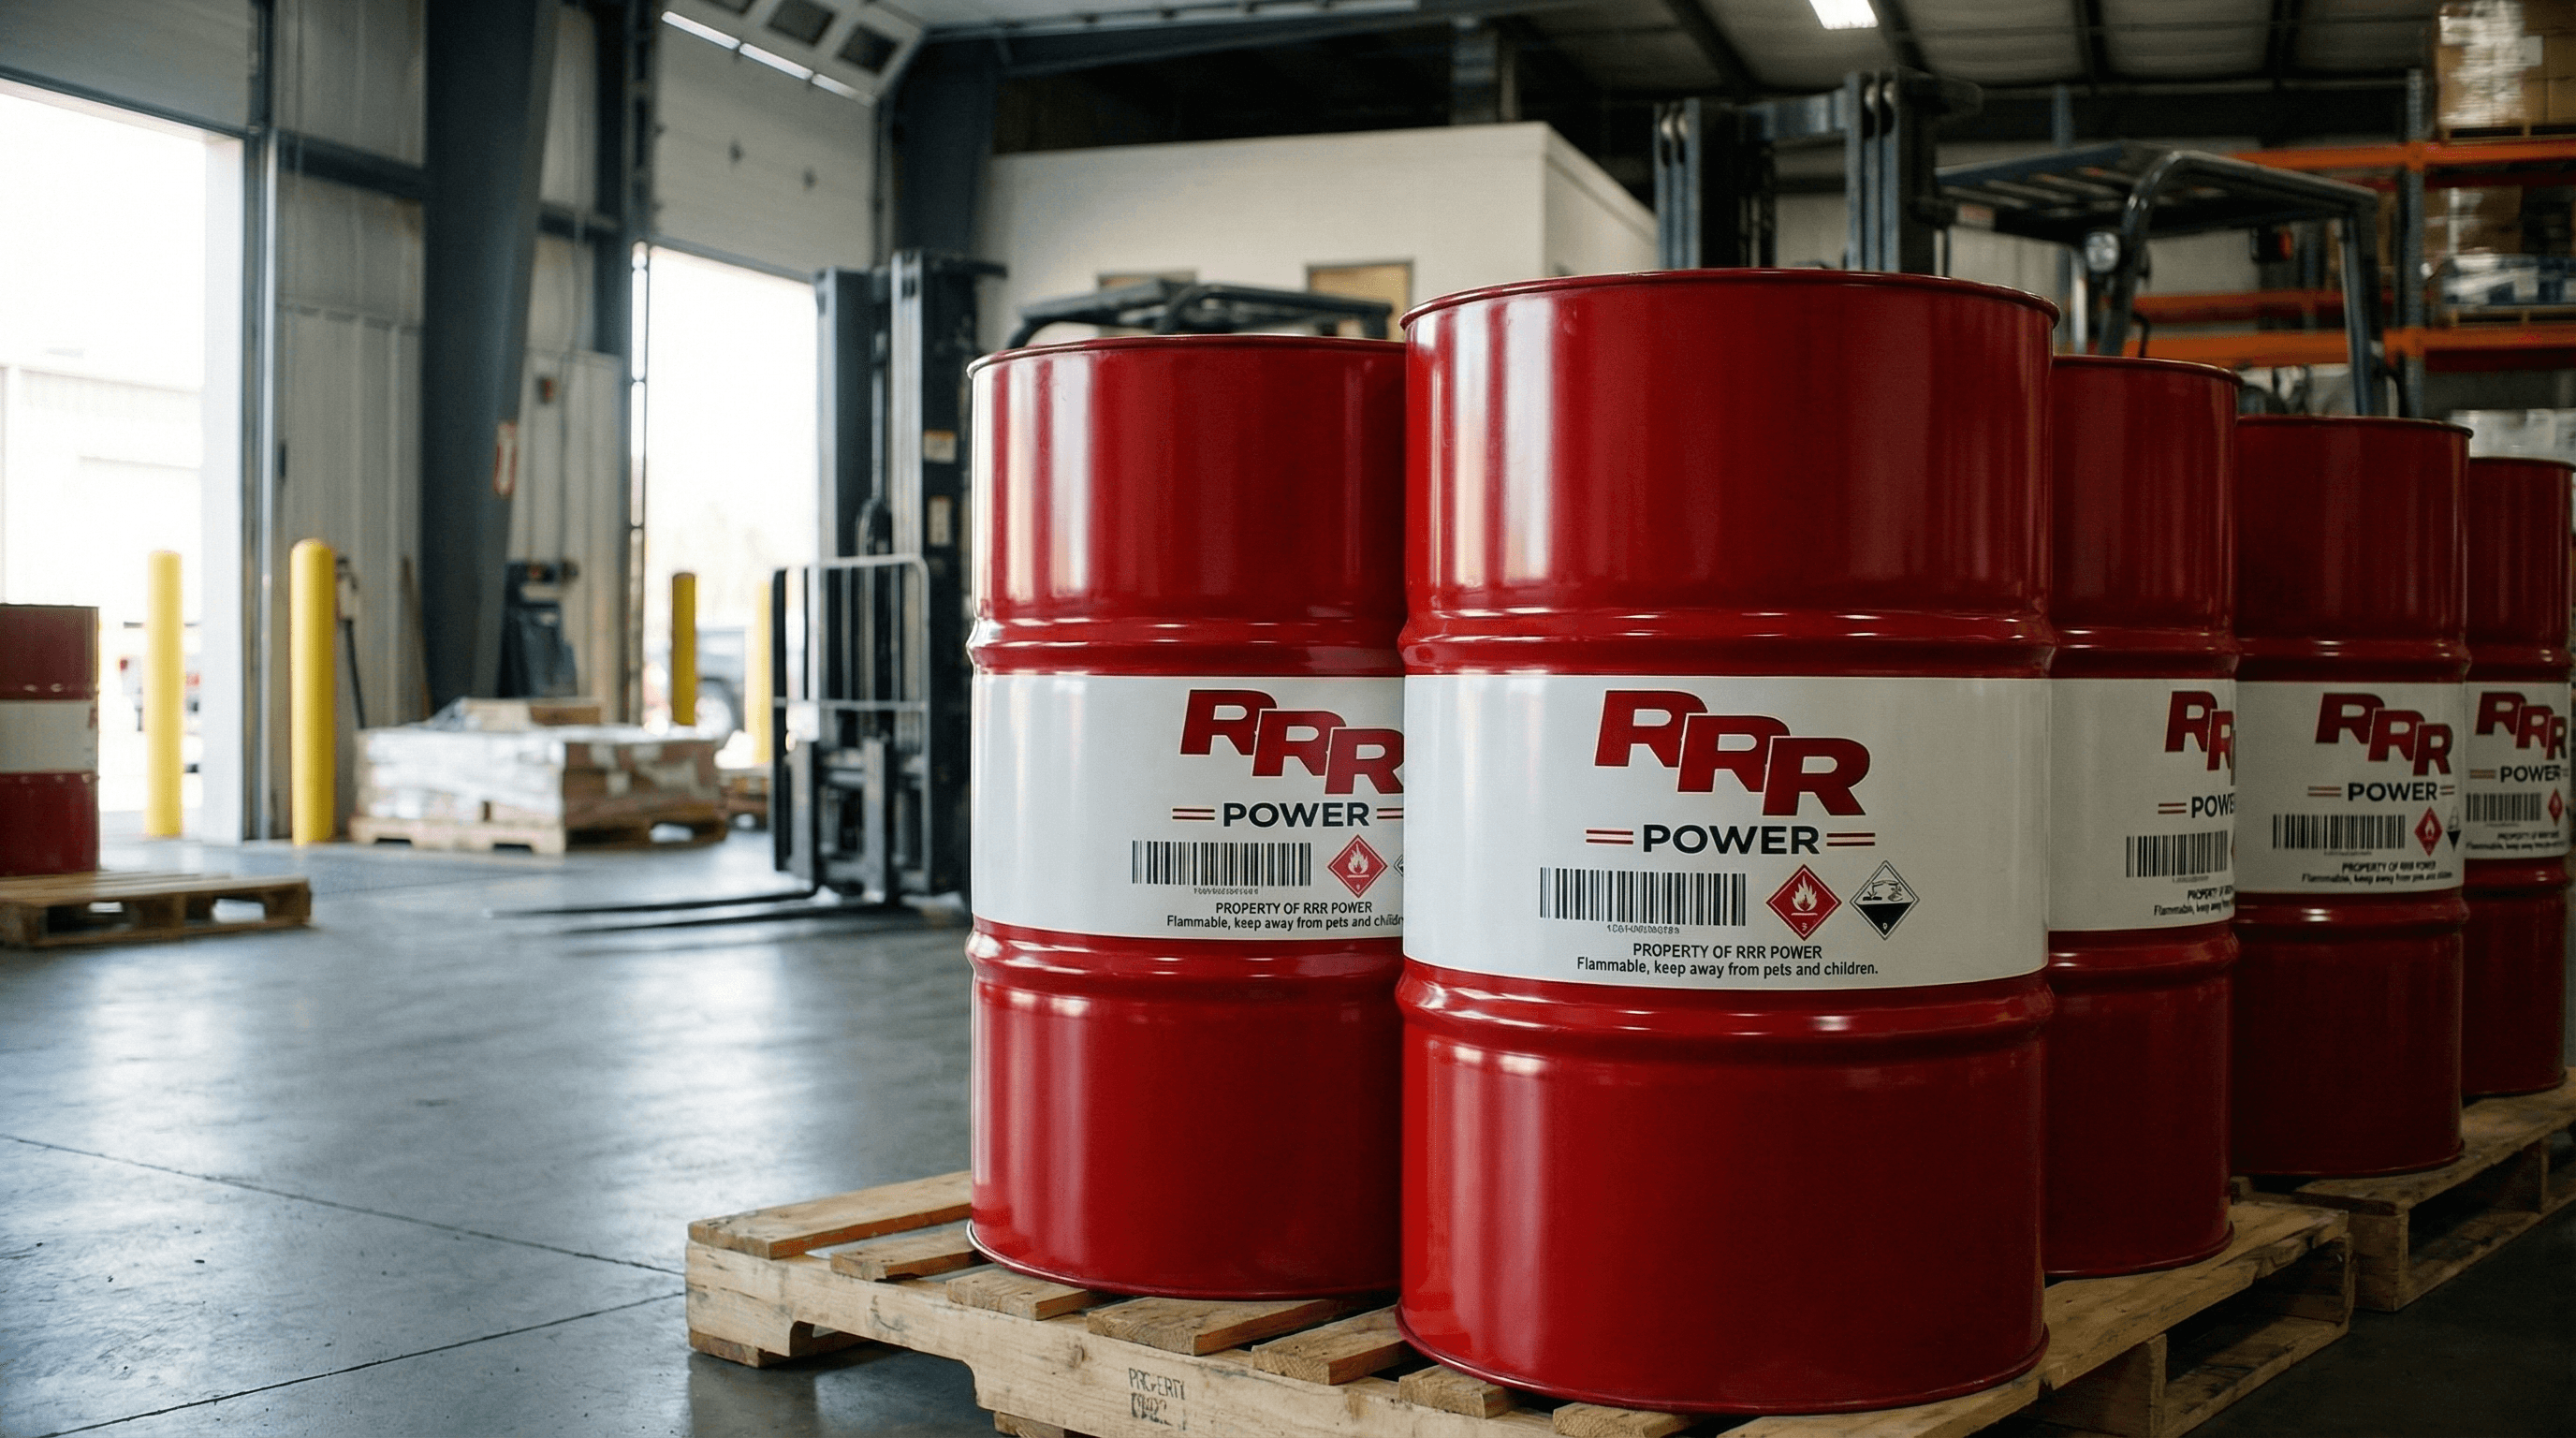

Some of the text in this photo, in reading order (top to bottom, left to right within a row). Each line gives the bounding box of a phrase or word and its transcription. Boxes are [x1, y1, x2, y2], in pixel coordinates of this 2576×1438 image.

[2315, 693, 2453, 776] RRR
[2476, 692, 2567, 760] RRR
[1180, 689, 1403, 795] RRR
[1594, 690, 1870, 816] RRR
[2348, 782, 2437, 801] POWER
[1223, 802, 1369, 828] POWER
[1643, 824, 1820, 855] POWER
[1215, 902, 1373, 915] PROPERTY OF RRR POWER
[1166, 915, 1231, 930] Flammable,
[1234, 917, 1261, 932] keep
[1265, 919, 1294, 932] away
[1296, 917, 1323, 929] from
[1325, 917, 1349, 931] pets
[1352, 916, 1371, 927] and
[1633, 943, 1822, 959] PROPERTY OF RRR POWER
[1577, 957, 1879, 979] Flammable, keep away from pets and children.
